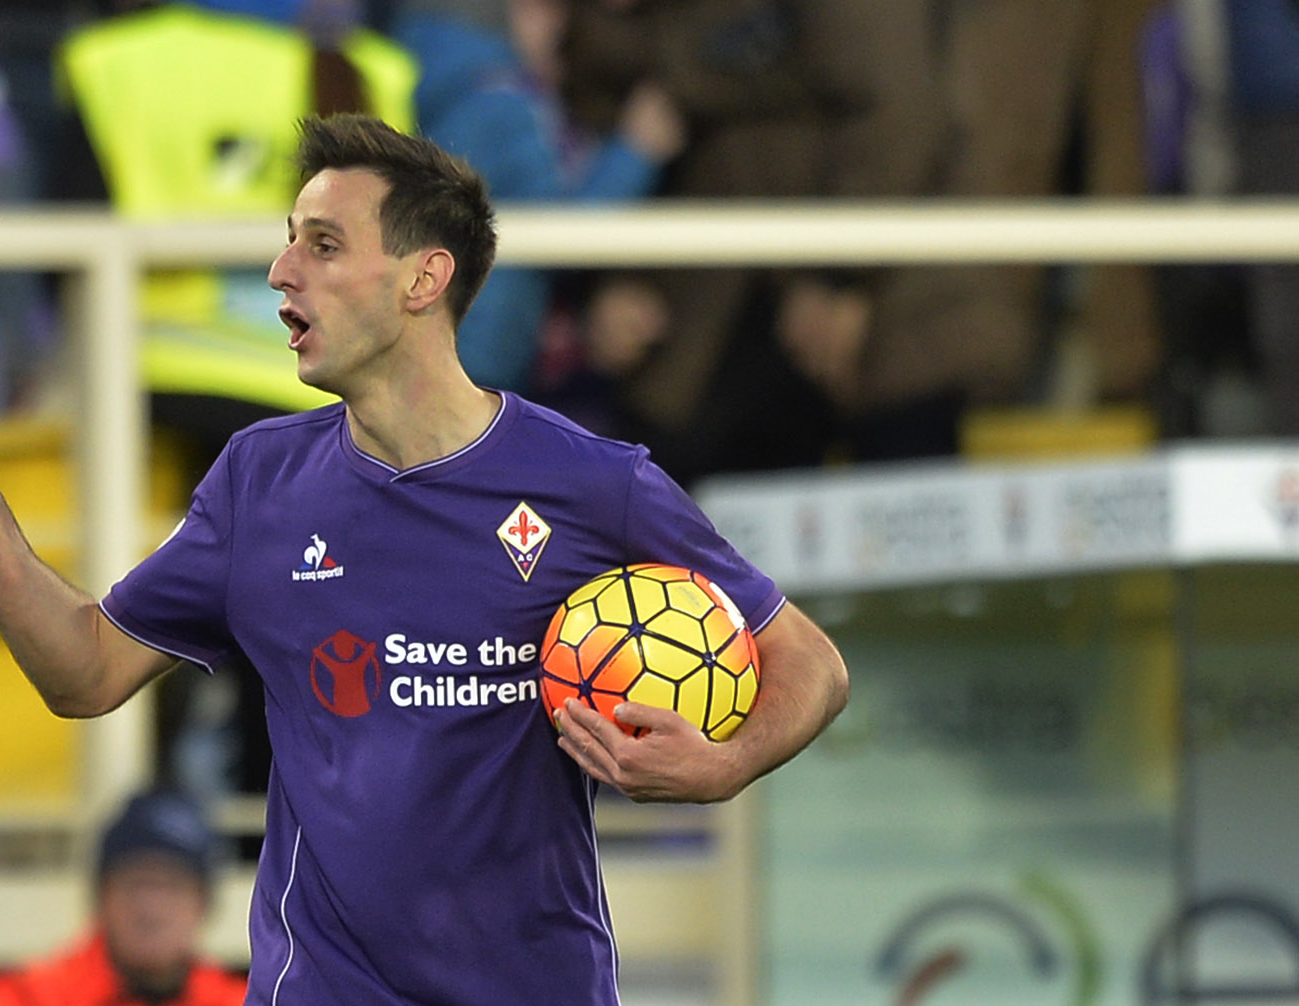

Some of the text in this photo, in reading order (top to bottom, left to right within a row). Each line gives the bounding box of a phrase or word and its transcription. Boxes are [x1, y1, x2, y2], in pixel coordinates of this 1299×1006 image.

[384, 633, 537, 666] Save the
[389, 675, 538, 707] Children
